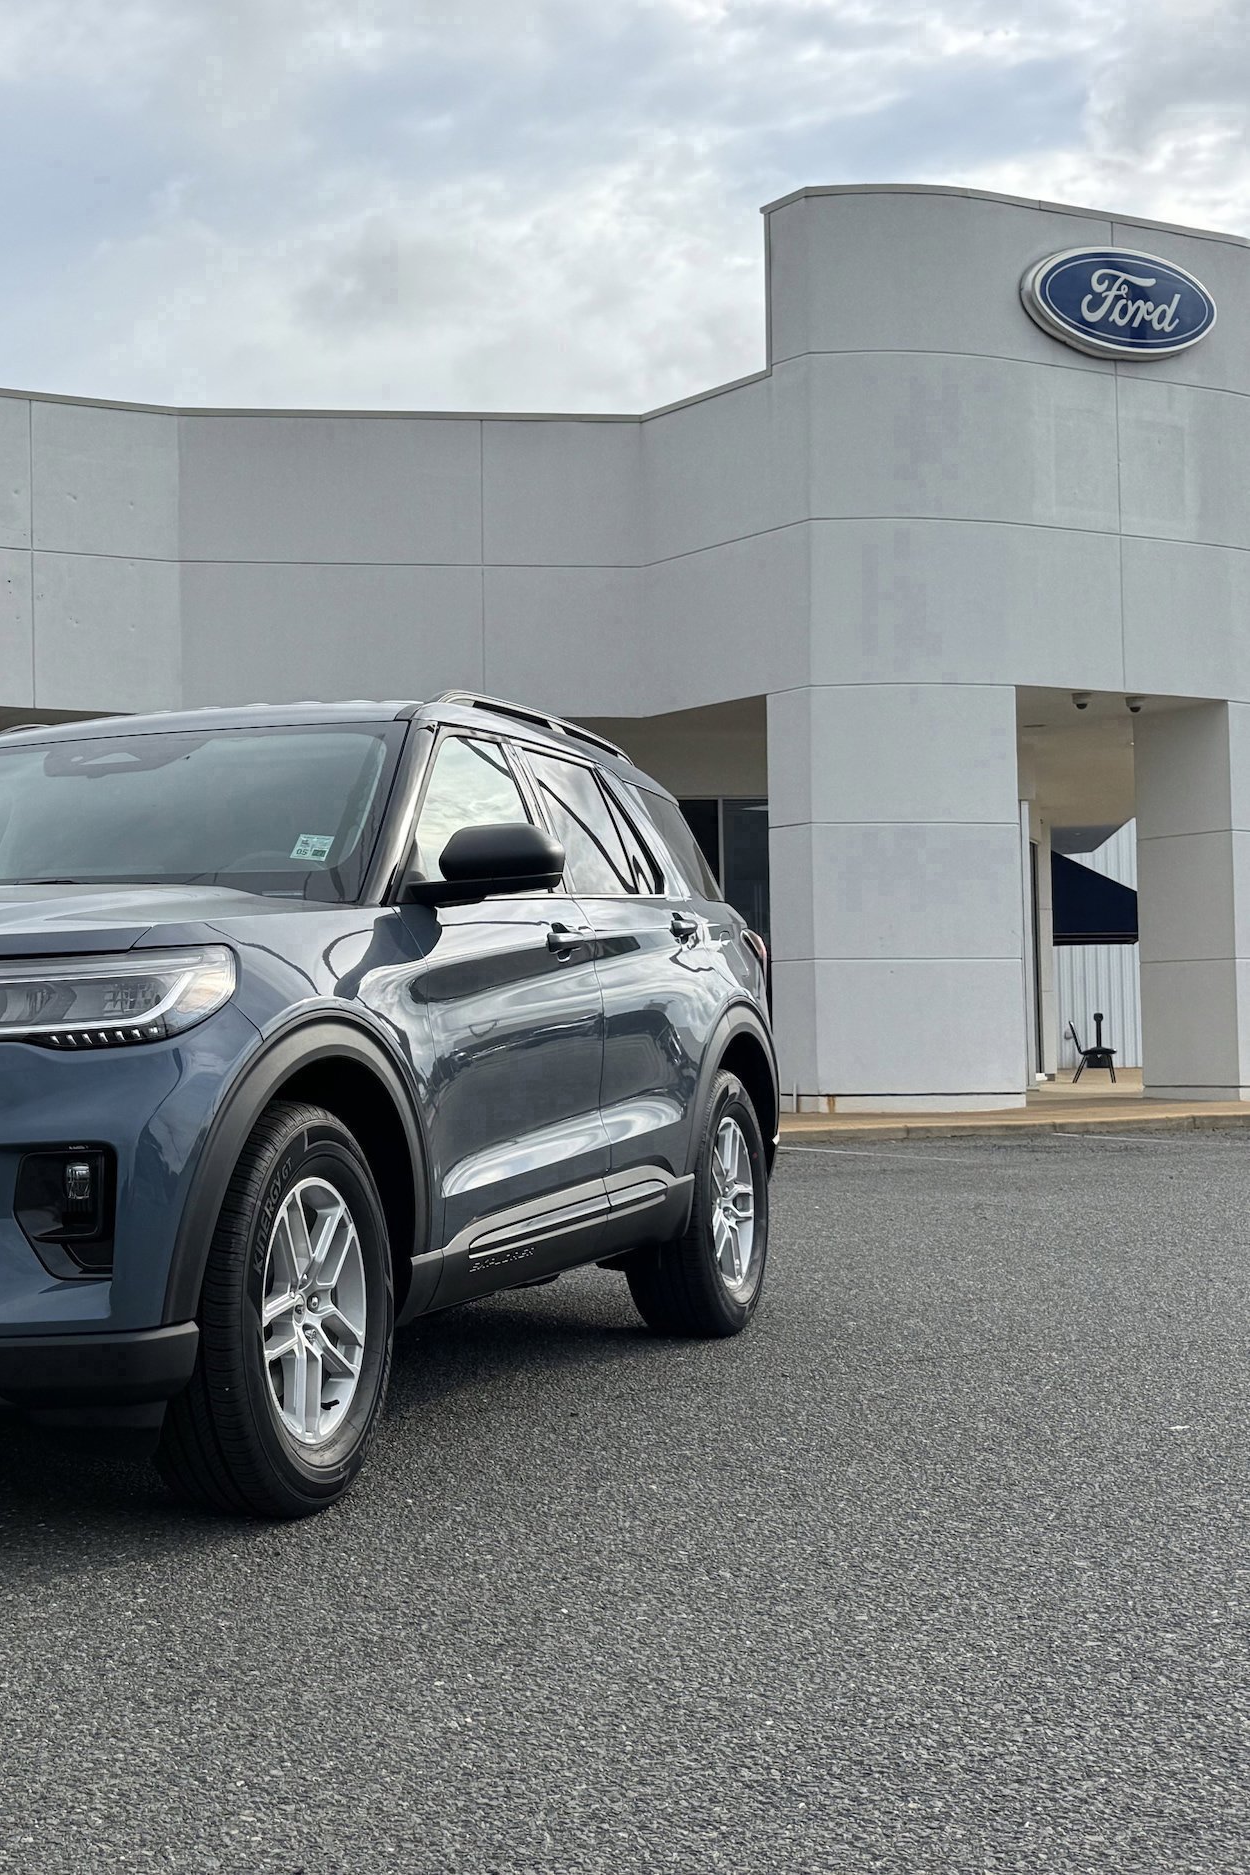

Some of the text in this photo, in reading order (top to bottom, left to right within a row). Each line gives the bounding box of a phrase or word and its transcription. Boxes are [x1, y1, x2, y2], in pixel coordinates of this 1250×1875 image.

[1081, 268, 1181, 333] Ford
[253, 1157, 293, 1276] KINERGY GT
